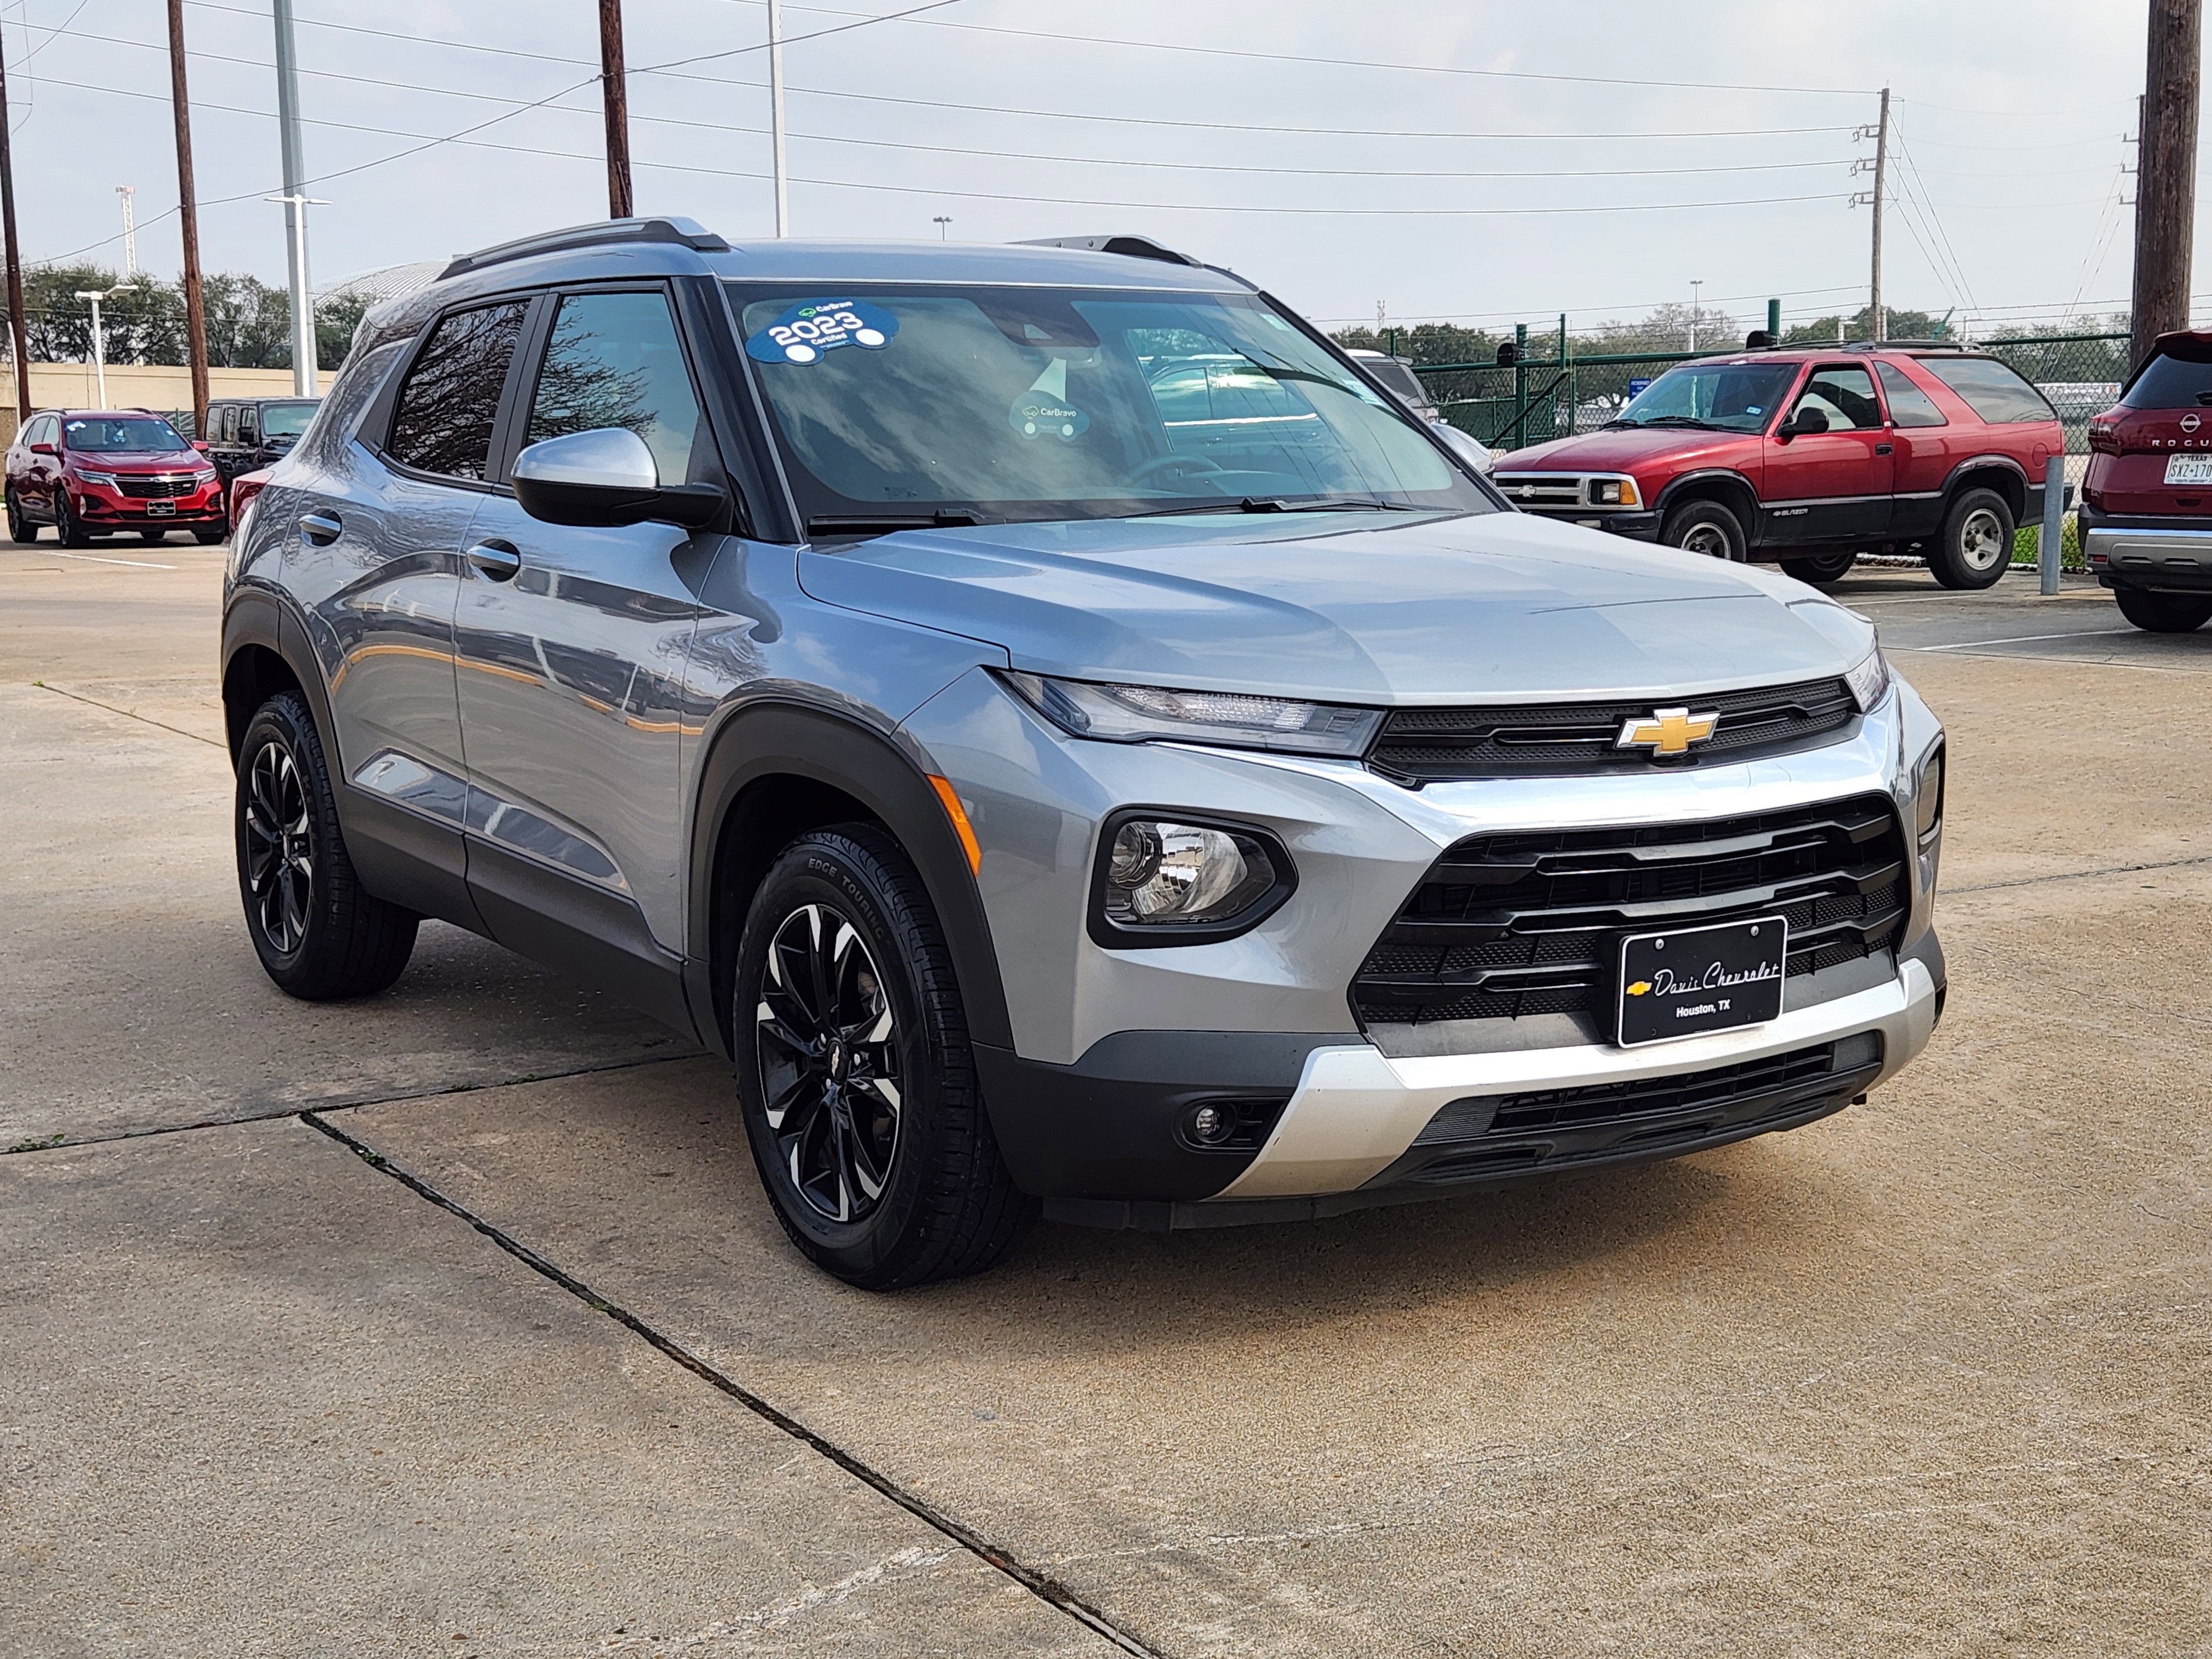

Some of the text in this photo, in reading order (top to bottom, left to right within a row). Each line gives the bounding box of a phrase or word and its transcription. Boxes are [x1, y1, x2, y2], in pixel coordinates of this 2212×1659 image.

[768, 311, 864, 346] 2023
[810, 332, 848, 345] Certified
[1040, 408, 1077, 417] CarBravo
[807, 857, 885, 940] EDGE TOURING
[1703, 961, 1781, 989] Chevrolet
[1676, 999, 1731, 1018] Houston, TX
